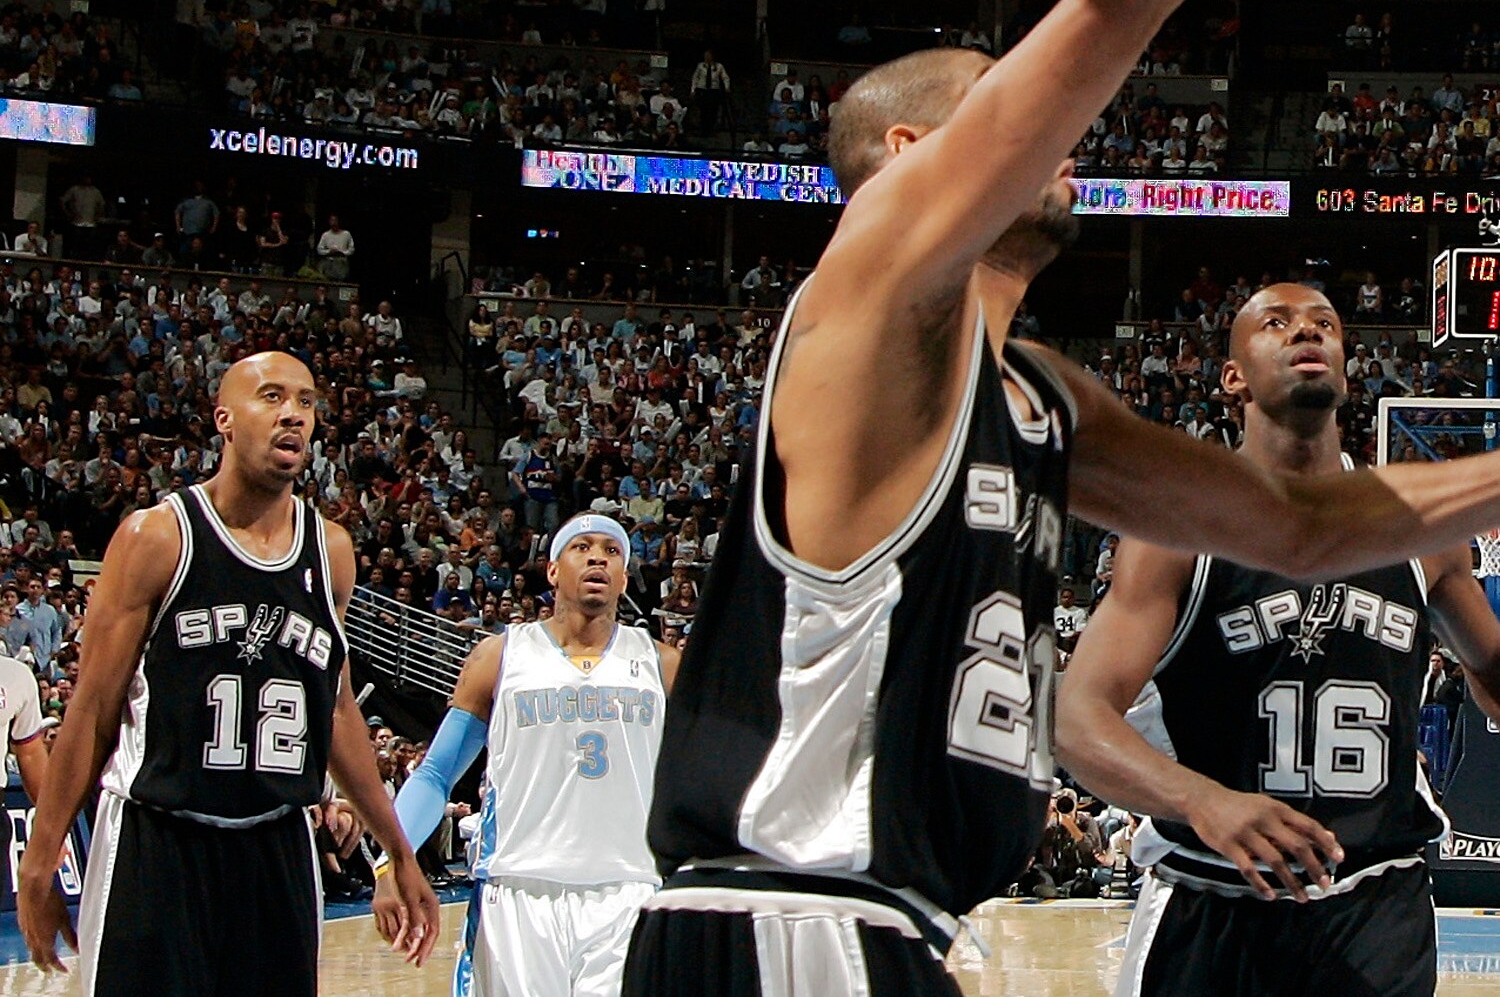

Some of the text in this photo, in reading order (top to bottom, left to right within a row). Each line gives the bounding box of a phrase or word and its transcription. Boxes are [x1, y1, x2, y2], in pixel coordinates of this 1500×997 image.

[209, 126, 418, 169] xcelenergy.com
[648, 177, 761, 200] MEDICAL
[709, 159, 821, 185] SWEDISH
[1142, 184, 1203, 211] Right
[1316, 189, 1356, 212] 603
[1364, 189, 1425, 213] Santa
[1432, 191, 1458, 213] Fe
[175, 603, 332, 671] SPURS
[1056, 615, 1074, 632] 34
[1216, 582, 1418, 665] SPURS
[513, 684, 655, 729] NUGGETS
[947, 589, 1056, 793] 21
[202, 673, 308, 775] 12
[1257, 678, 1391, 799] 16
[574, 729, 610, 780] 3
